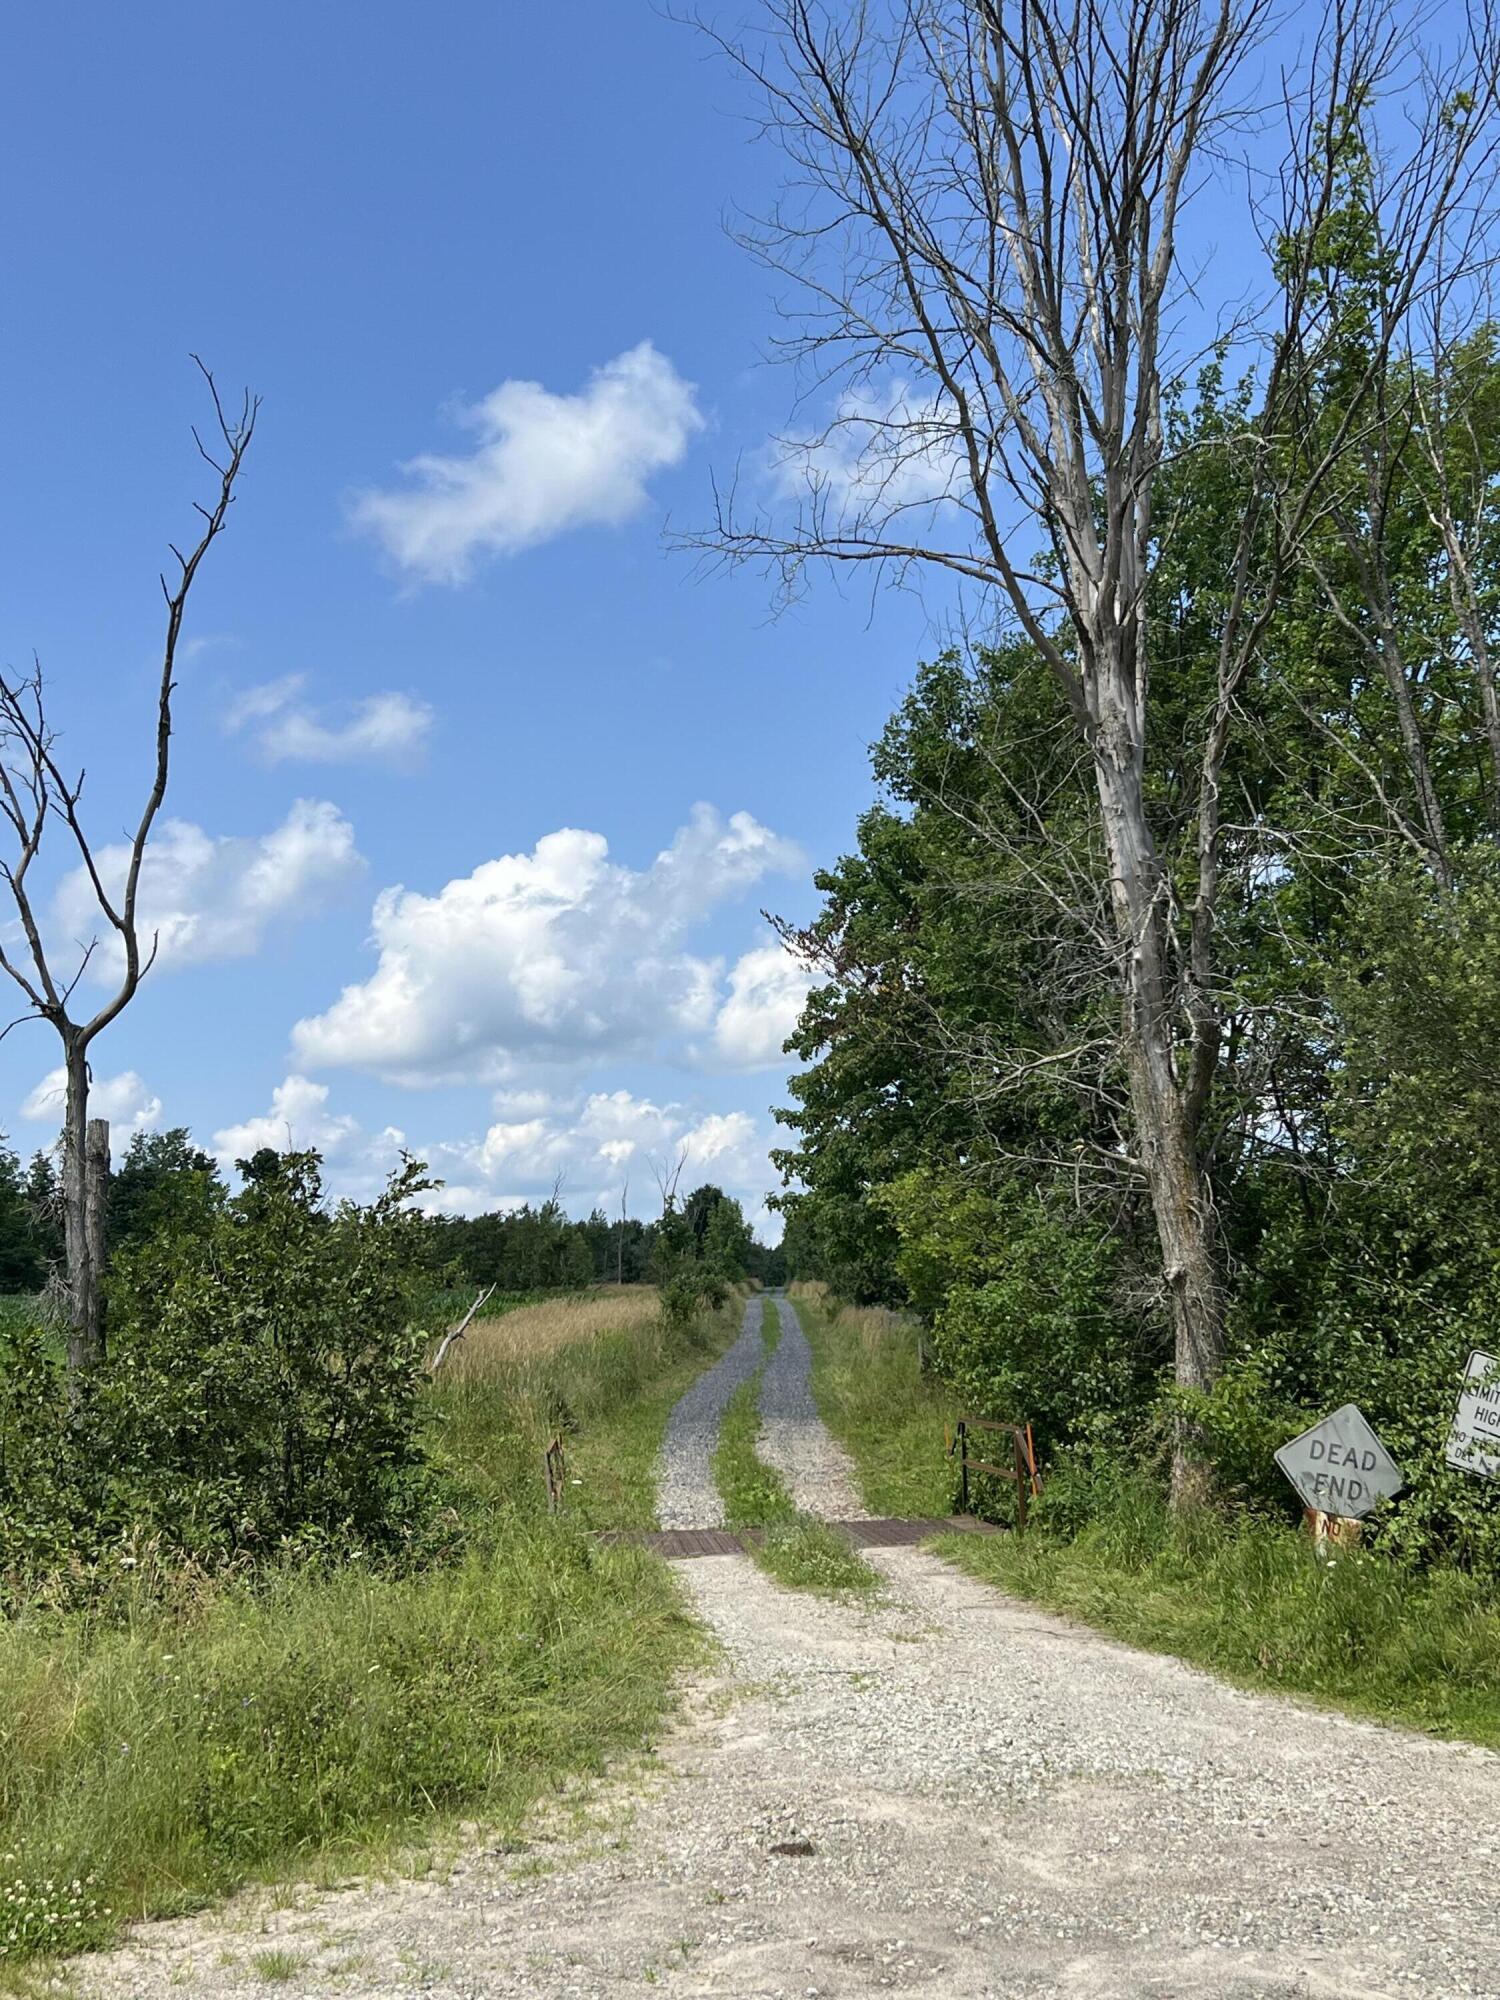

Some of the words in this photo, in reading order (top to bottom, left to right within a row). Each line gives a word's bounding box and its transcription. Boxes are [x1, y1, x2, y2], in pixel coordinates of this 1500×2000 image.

[1309, 1440, 1377, 1472] DEAD
[1313, 1473, 1363, 1500] END
[1322, 1519, 1342, 1536] NO
